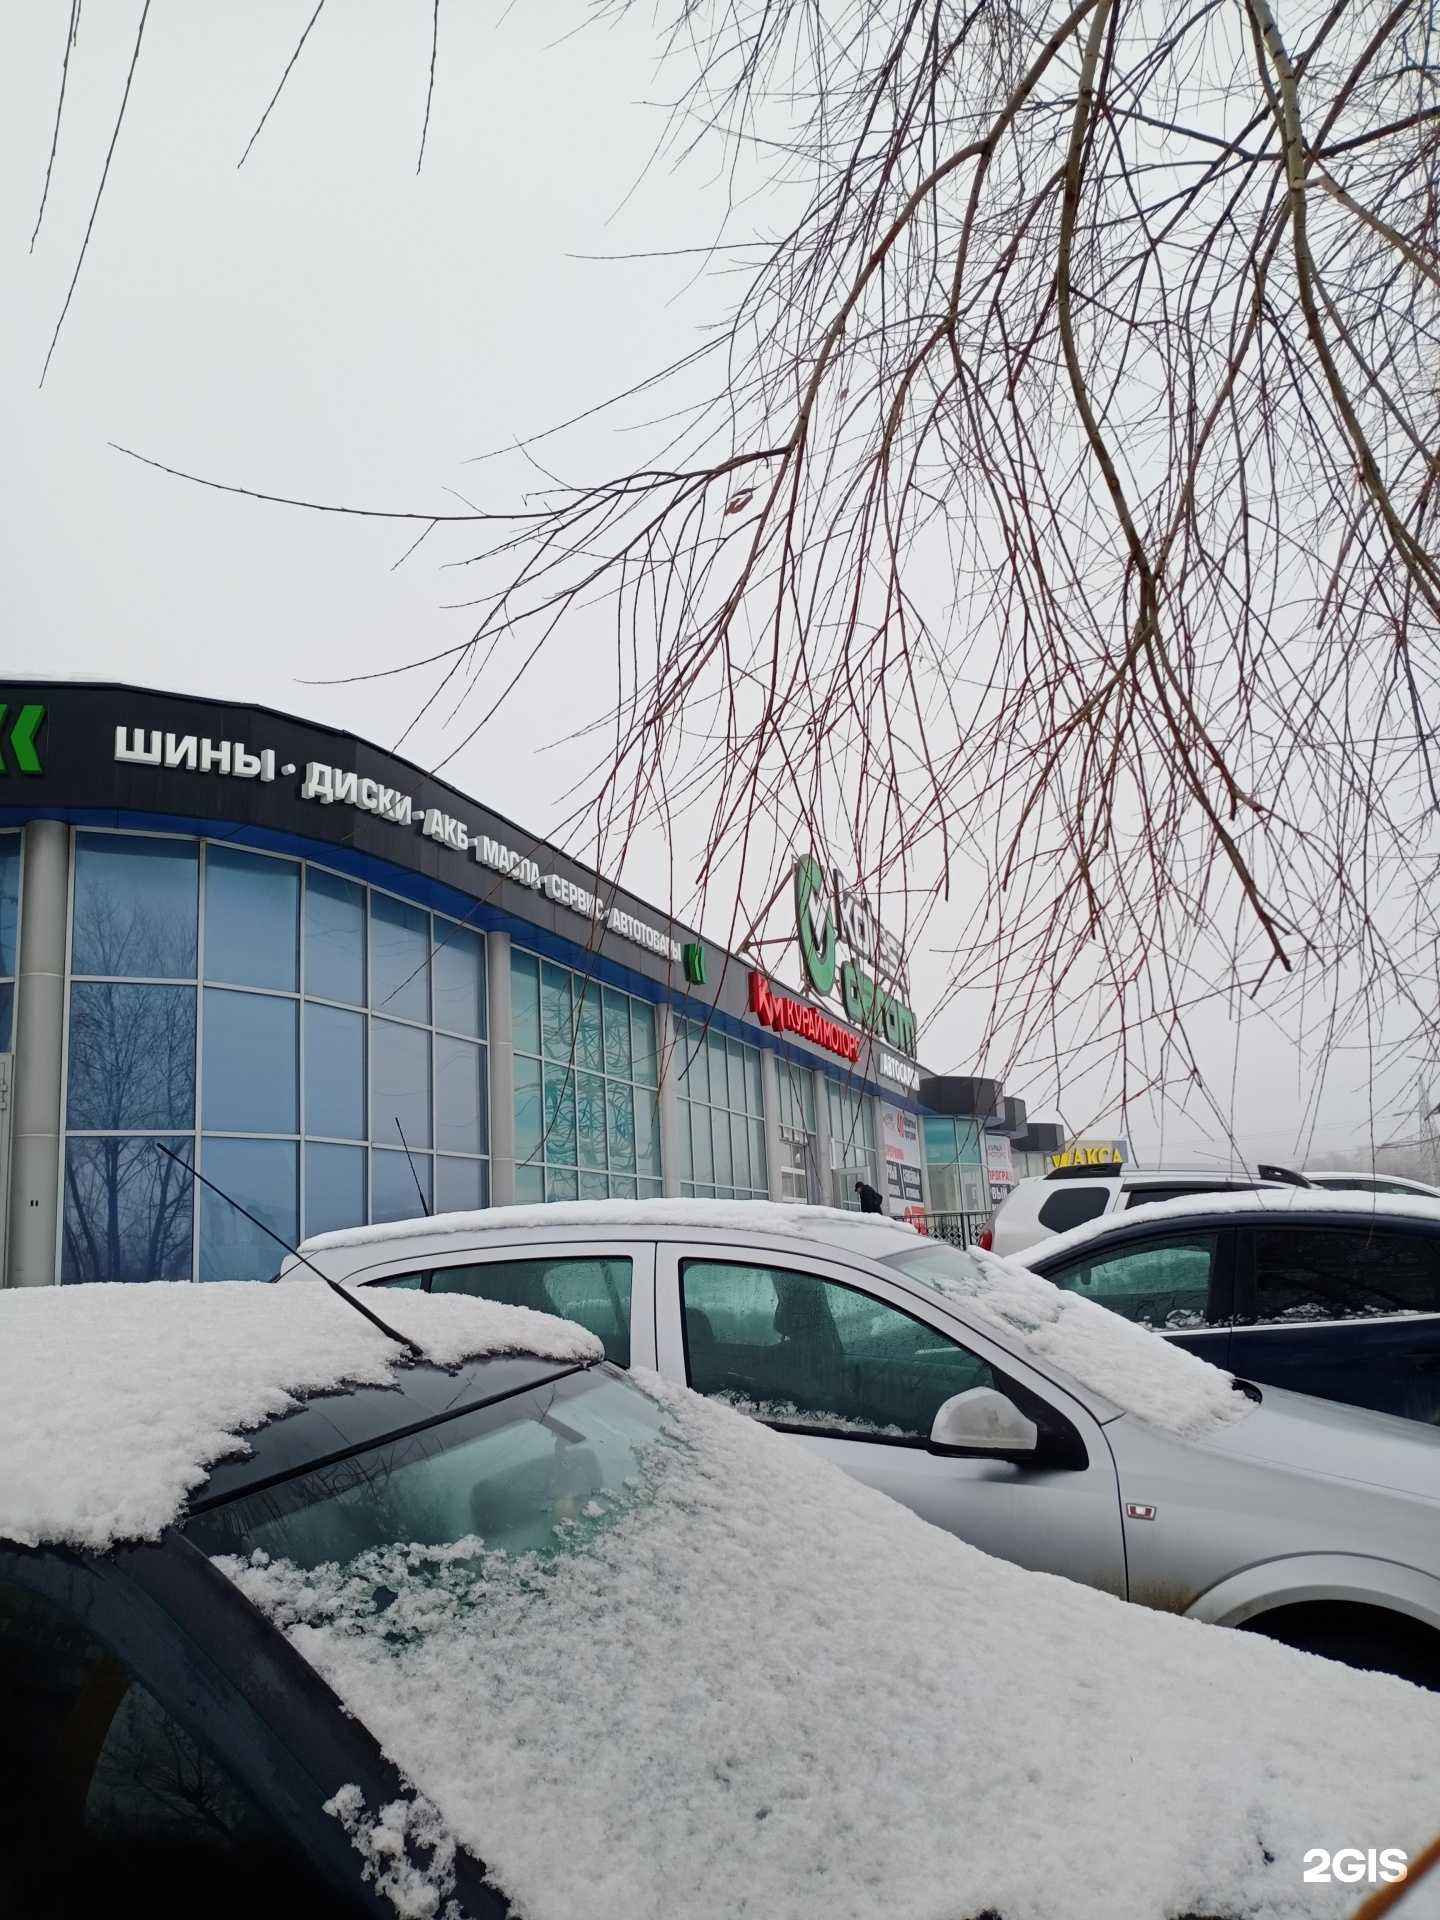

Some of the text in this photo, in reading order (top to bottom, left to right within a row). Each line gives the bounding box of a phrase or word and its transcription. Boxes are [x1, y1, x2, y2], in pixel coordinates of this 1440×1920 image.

[114, 725, 276, 782] ШИНЫ
[302, 761, 412, 826] ДИСКИ
[422, 808, 470, 851] АКБ
[475, 835, 542, 890] МАСЛА
[544, 874, 605, 921] СЕРВИС
